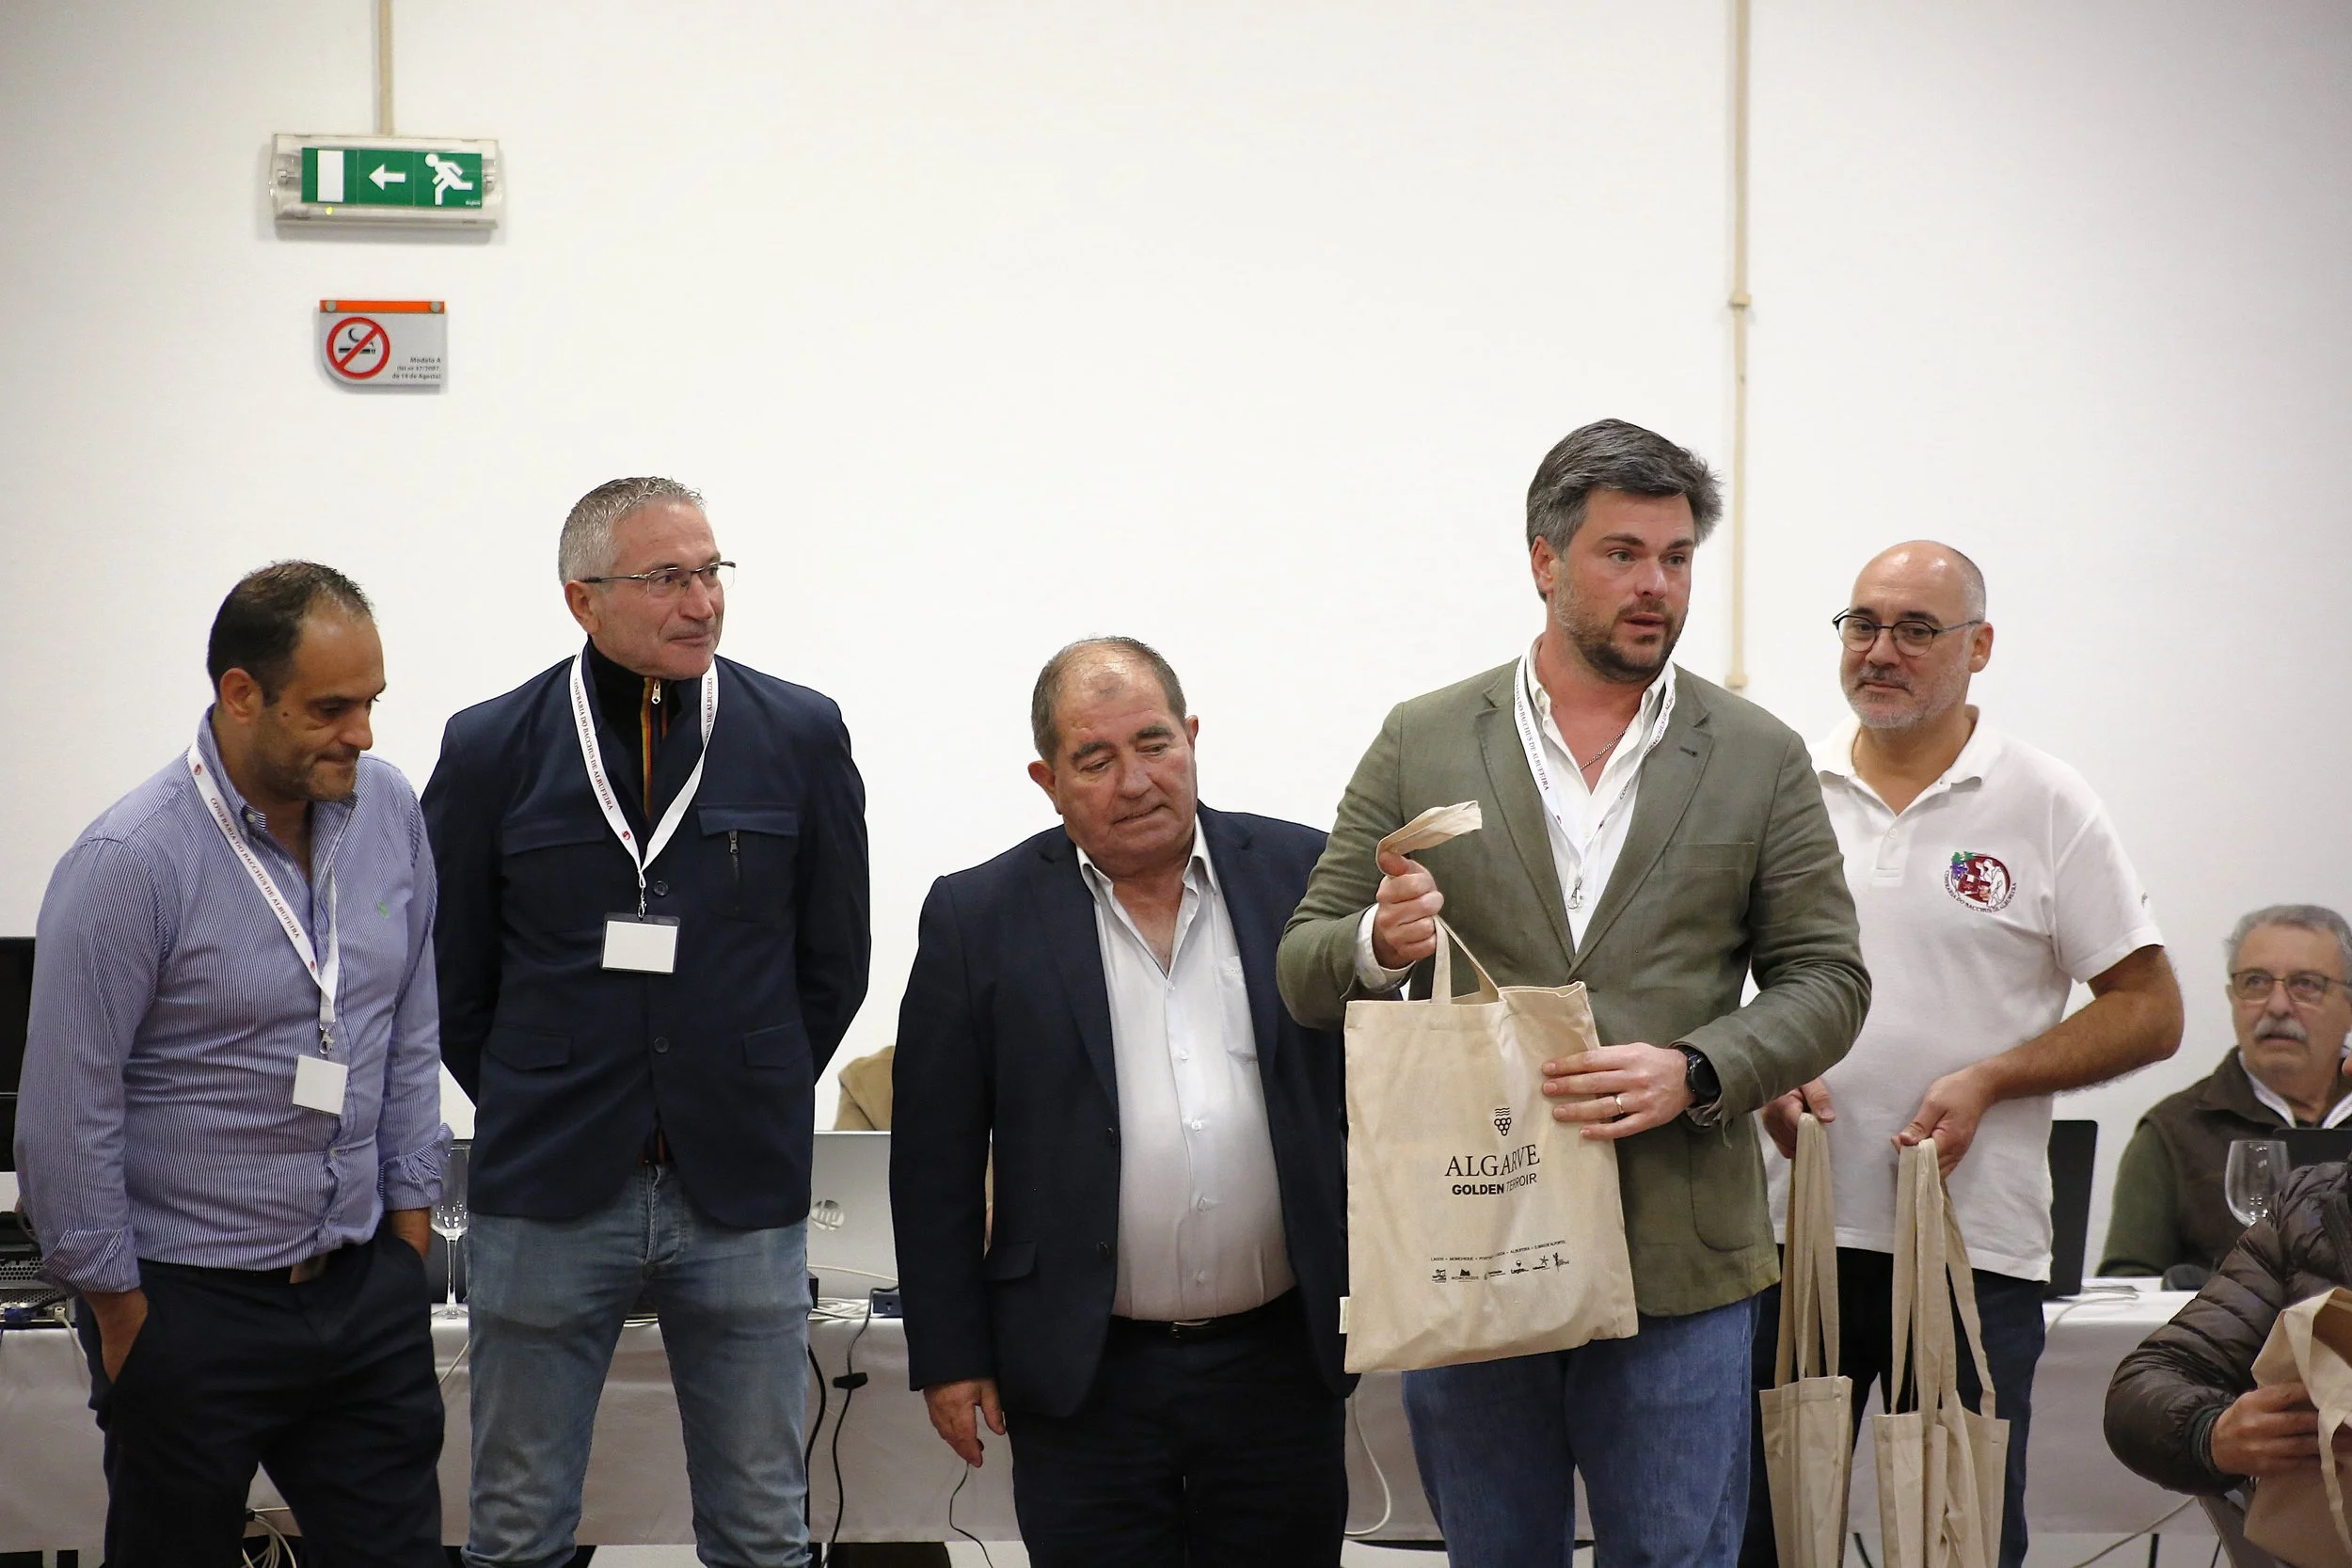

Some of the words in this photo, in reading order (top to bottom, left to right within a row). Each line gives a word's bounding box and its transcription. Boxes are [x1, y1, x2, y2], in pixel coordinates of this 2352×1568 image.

[580, 716, 587, 727] DO
[582, 725, 596, 760] BACCHUS
[591, 759, 597, 770] DE
[1528, 740, 1536, 752] DE
[1532, 752, 1549, 791] ALBUFEIRA
[593, 770, 613, 811] ALBUFEIRA
[211, 798, 236, 841] CONFRARIA
[234, 841, 244, 853] DO
[243, 852, 267, 886] BACCHUS
[265, 886, 274, 896] DE
[272, 897, 300, 939] ALBUFEIRA
[1444, 1144, 1540, 1177] ALGARVE
[1452, 1183, 1504, 1196] GOLDEN
[1505, 1172, 1537, 1192] TERROIR
